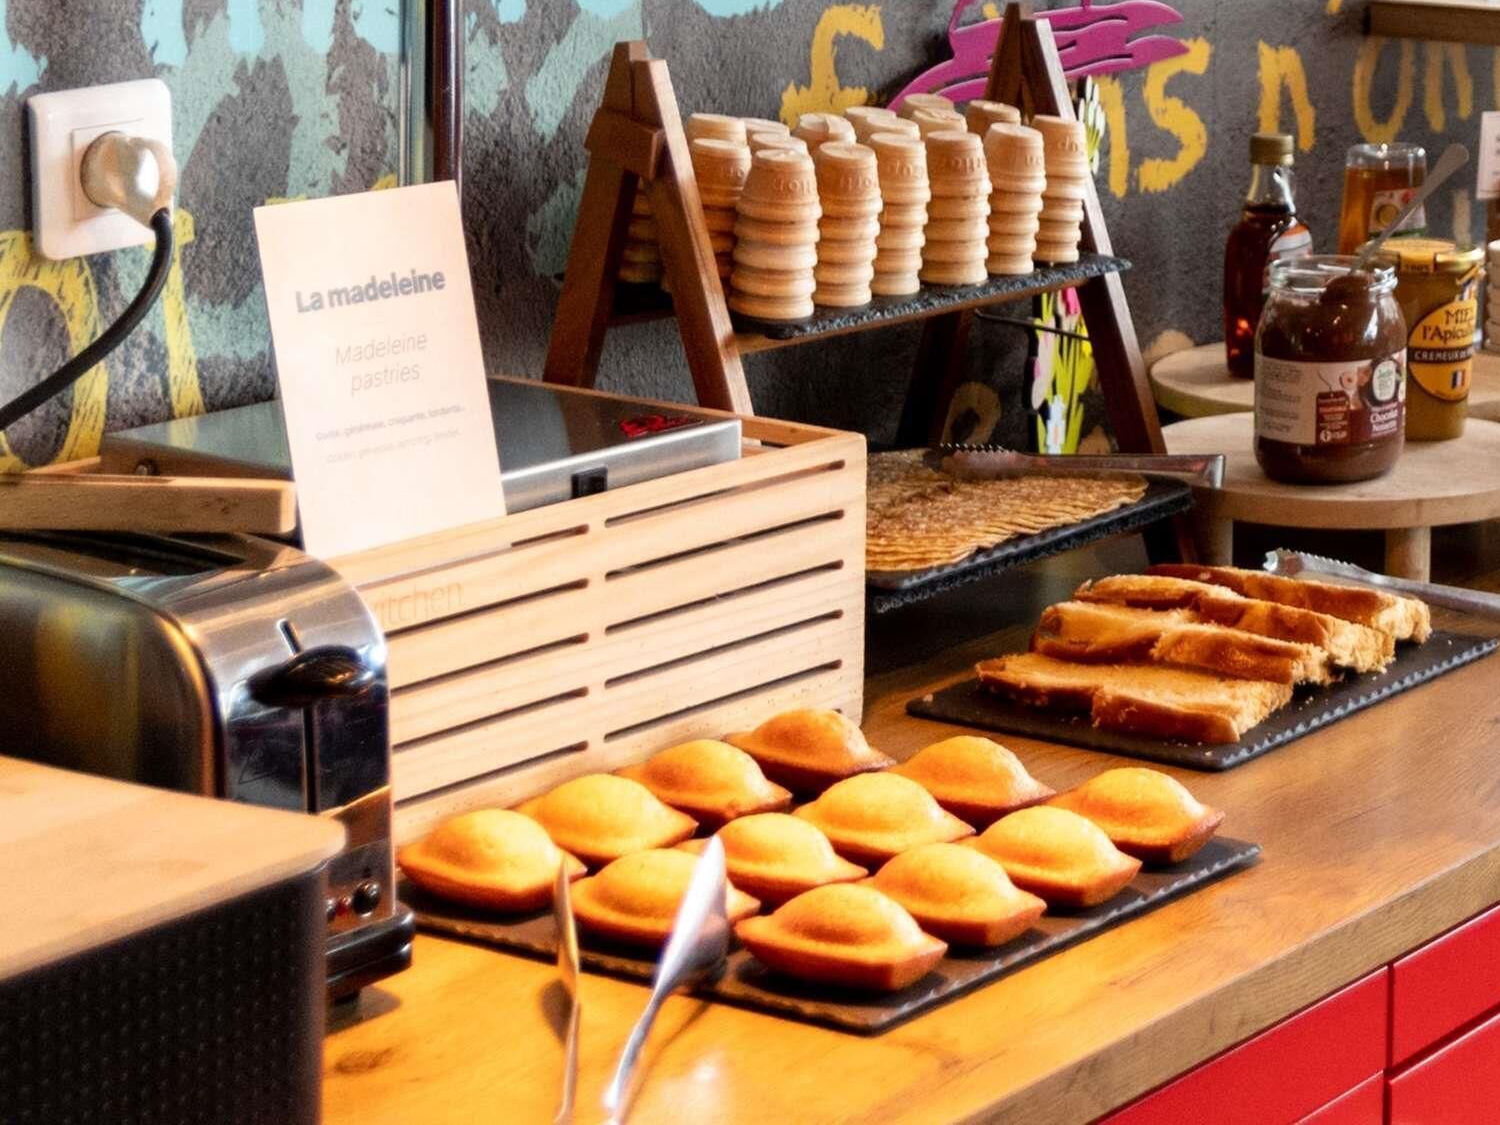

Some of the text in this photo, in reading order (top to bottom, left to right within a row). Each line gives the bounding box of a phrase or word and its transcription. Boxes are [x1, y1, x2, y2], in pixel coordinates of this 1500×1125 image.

[295, 268, 447, 314] La madeleine
[335, 331, 428, 367] Madeleine
[350, 361, 421, 399] pastries
